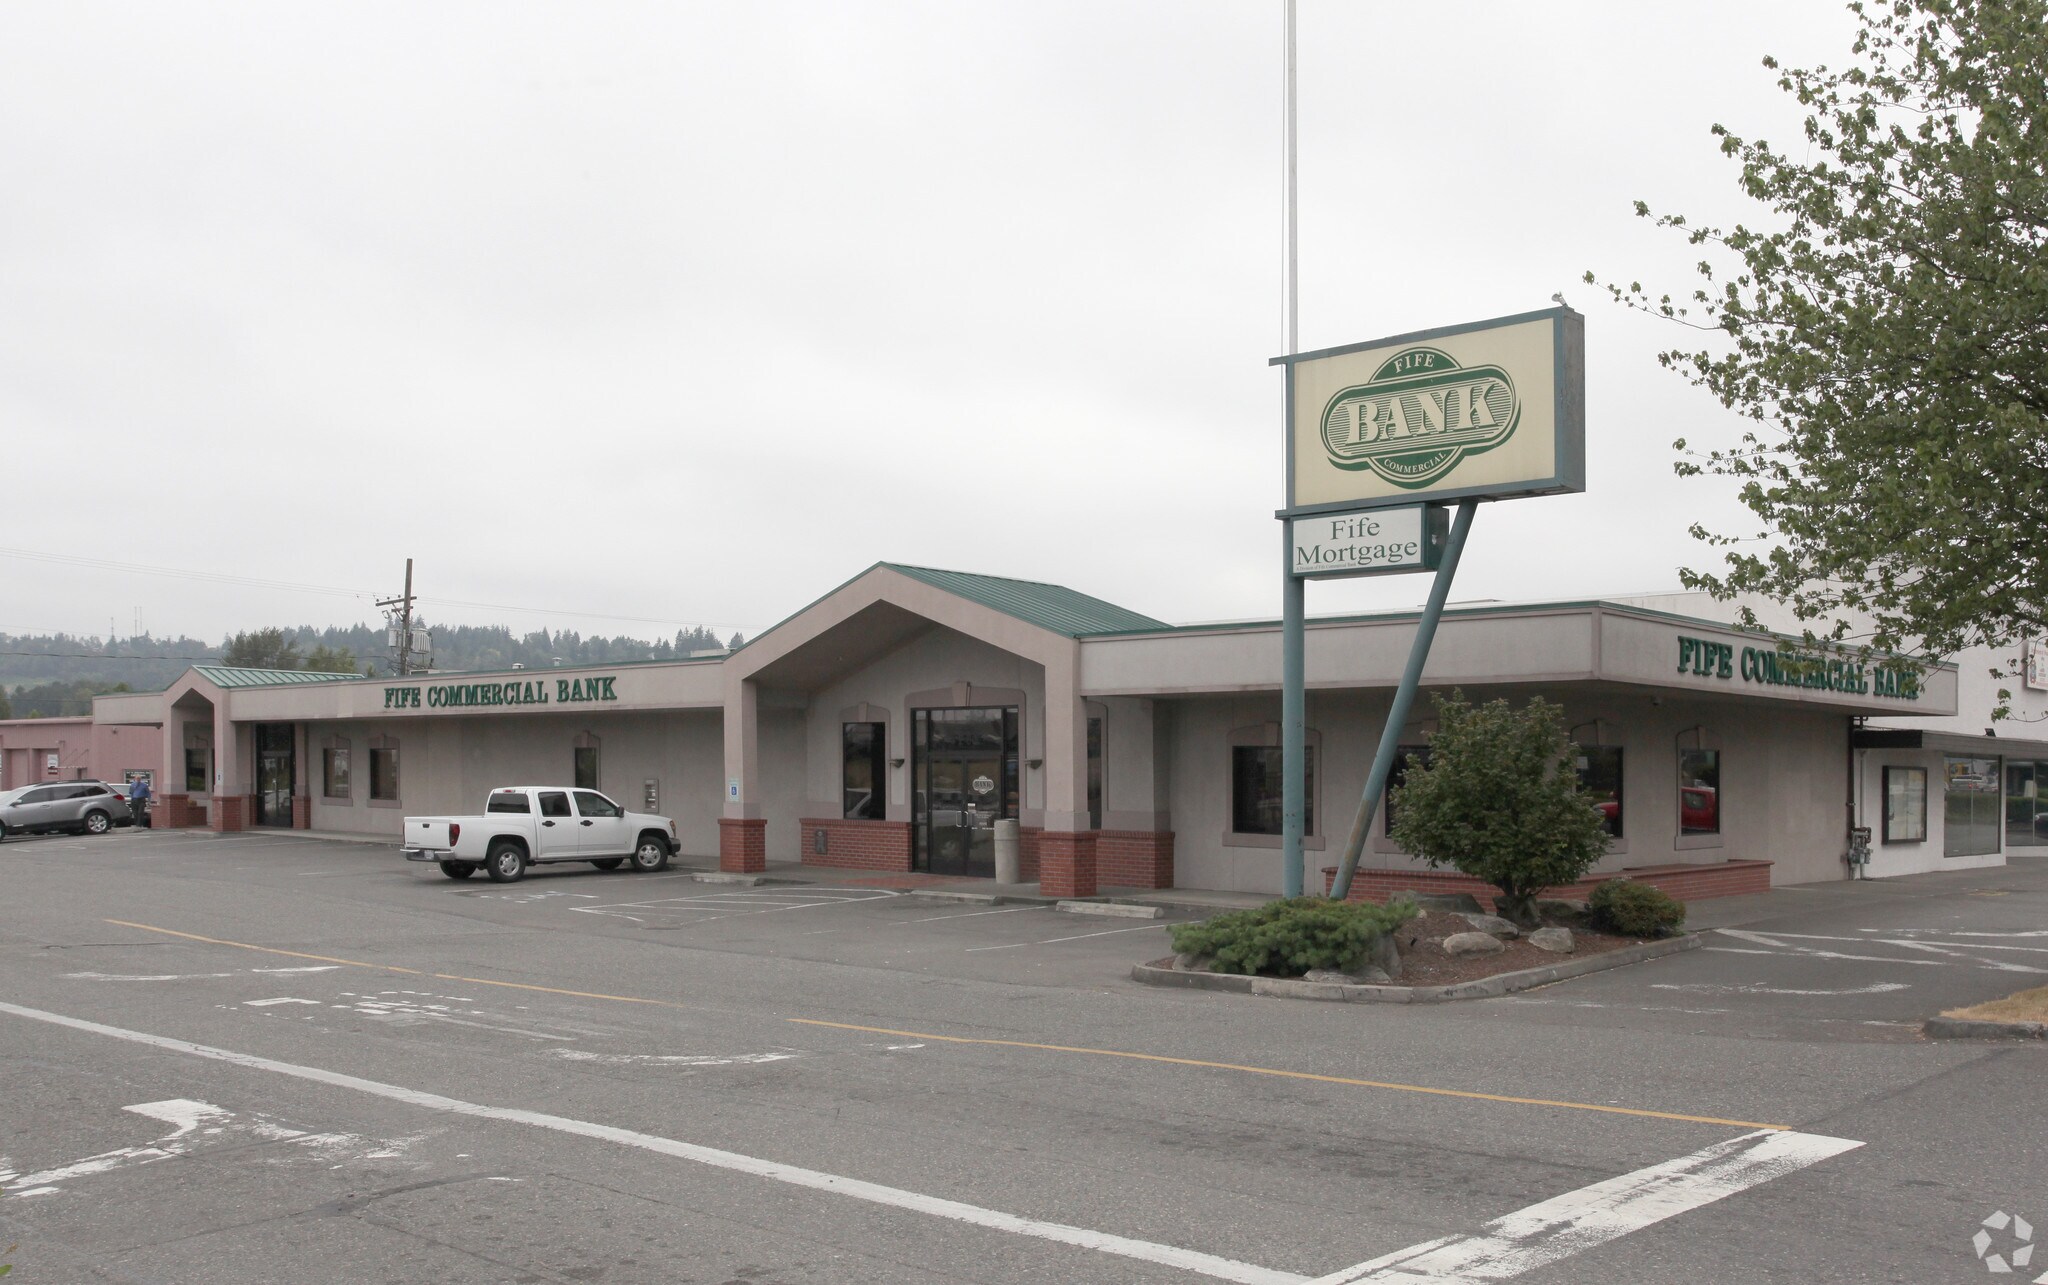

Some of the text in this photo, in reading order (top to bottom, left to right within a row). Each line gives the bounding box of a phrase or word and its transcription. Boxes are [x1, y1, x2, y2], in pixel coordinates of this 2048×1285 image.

[1393, 353, 1435, 374] FIFE
[1345, 383, 1500, 444] BANK
[1383, 452, 1447, 474] COMMERCIAL
[1330, 516, 1380, 540] Fife
[1296, 541, 1418, 565] Mortgage
[1677, 635, 1733, 679] FIFE
[384, 676, 618, 708] FIFE COMMERCIAL BANK
